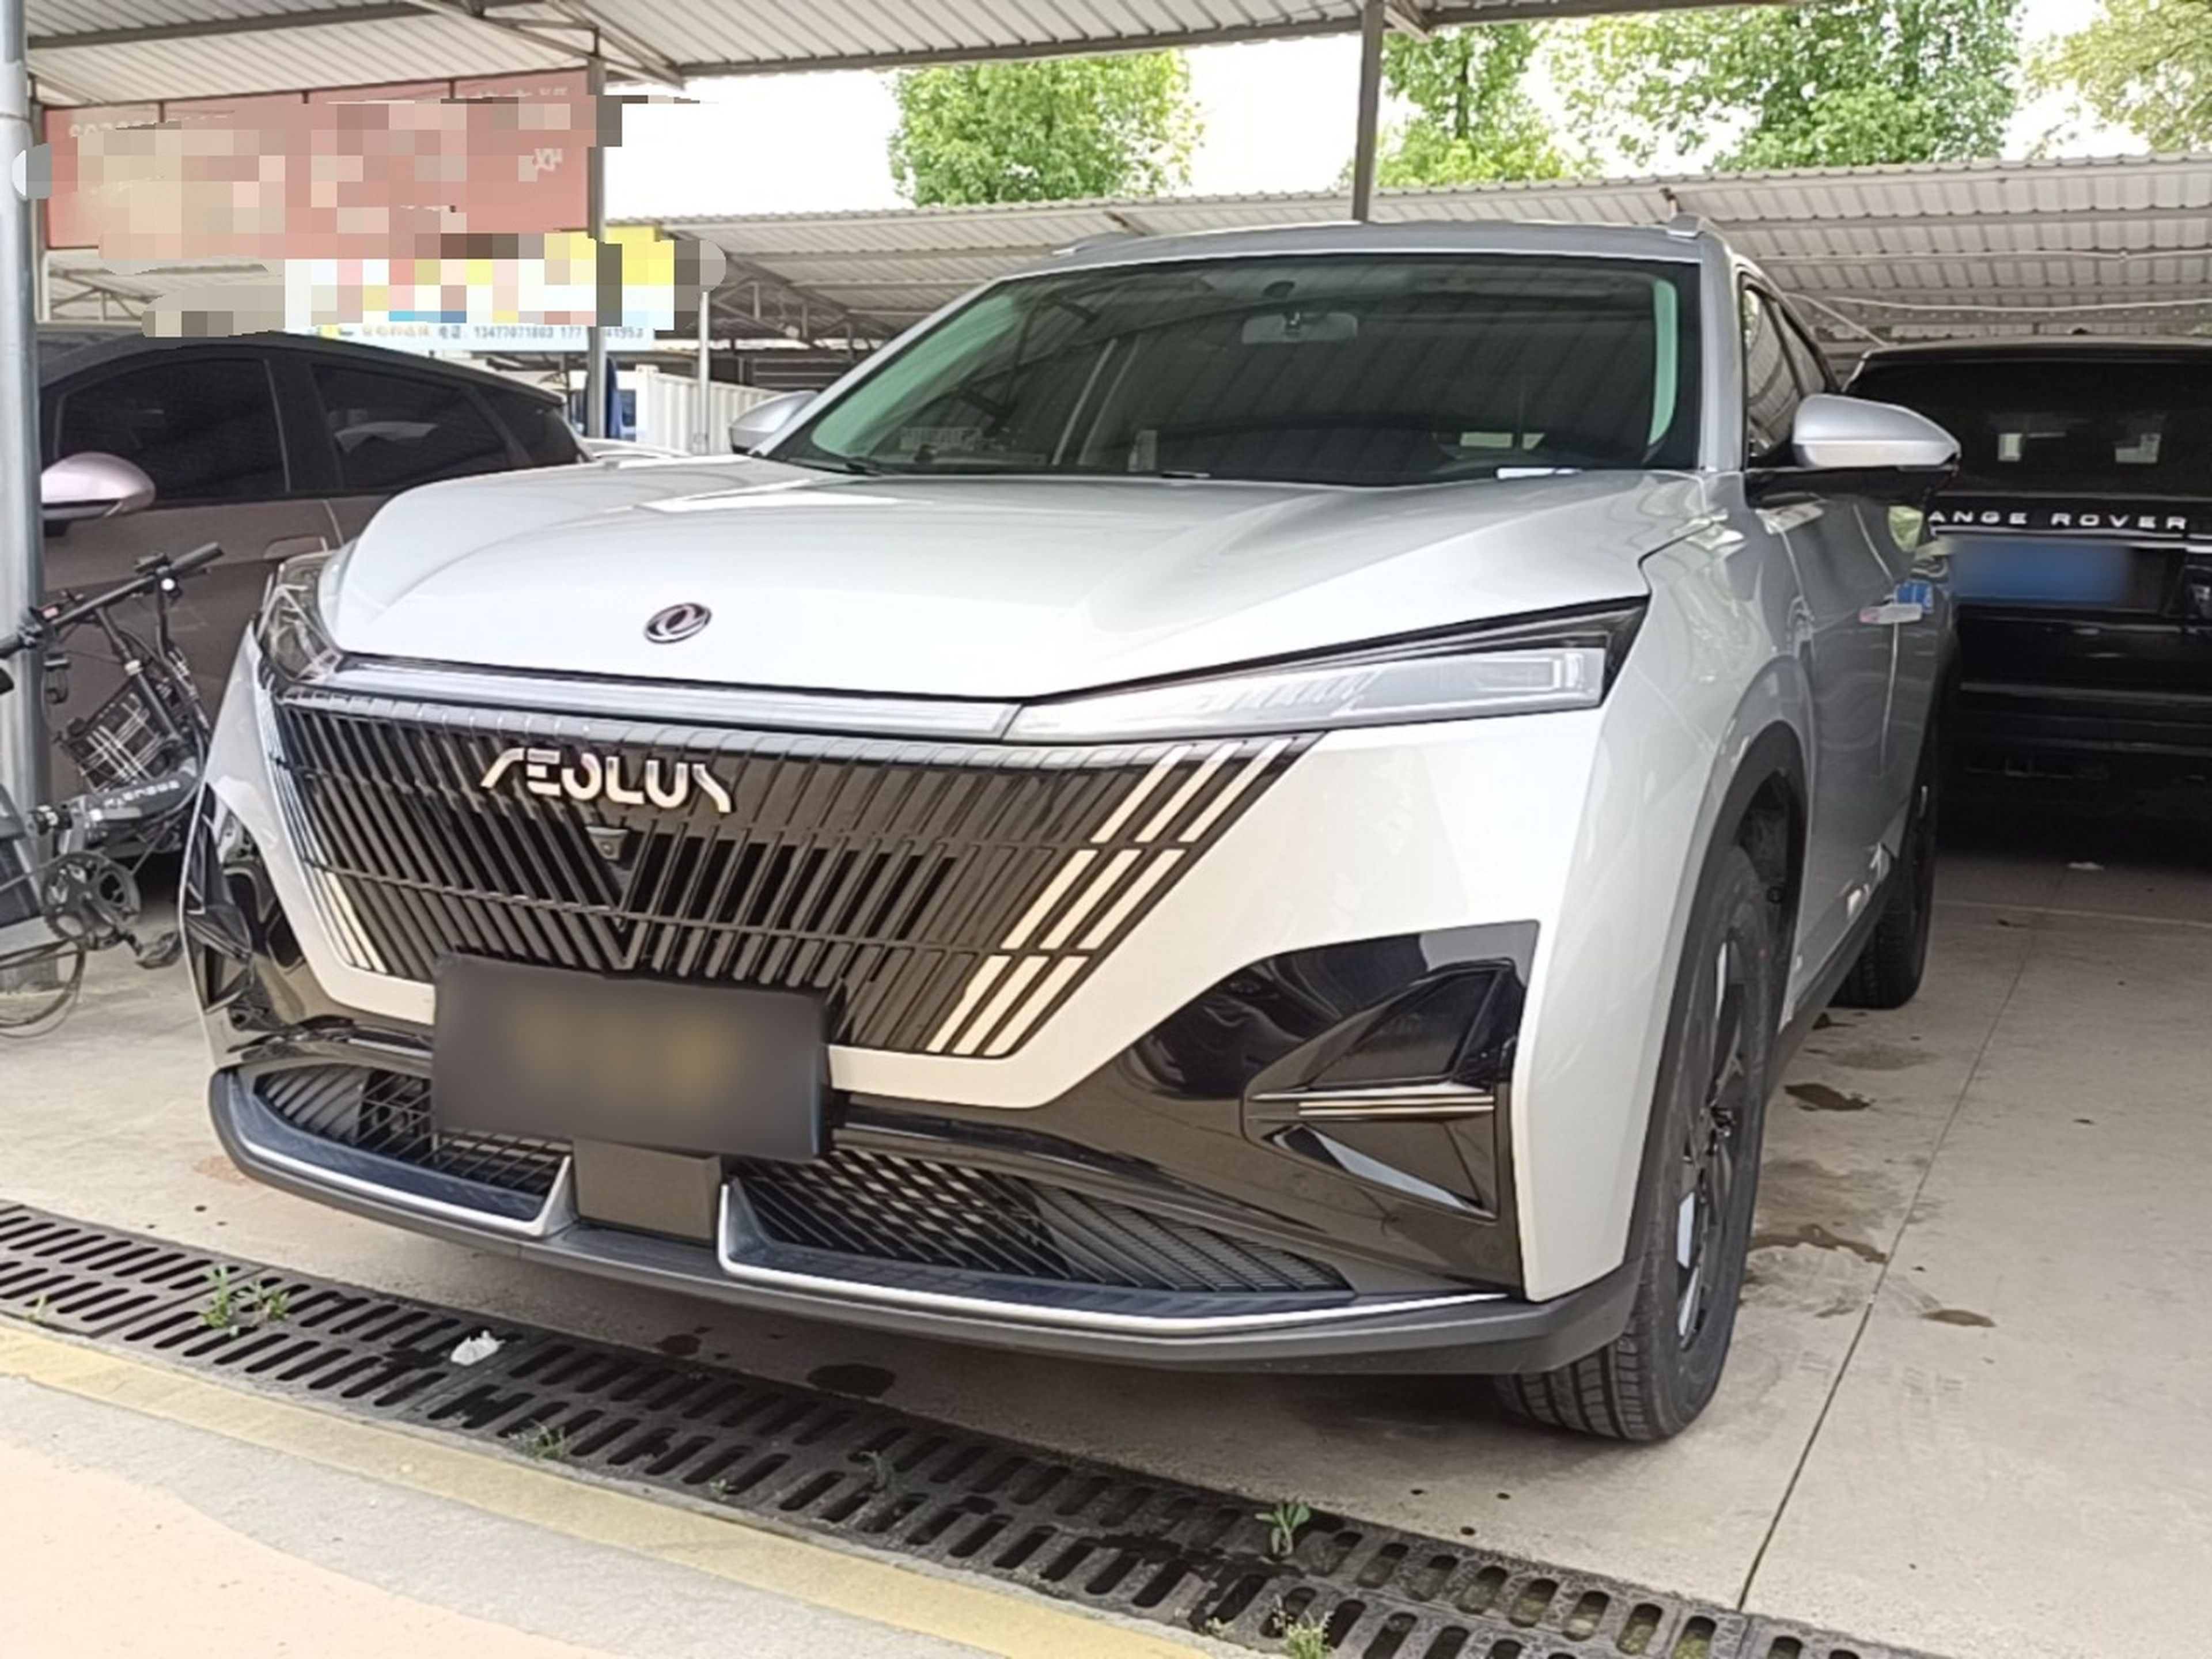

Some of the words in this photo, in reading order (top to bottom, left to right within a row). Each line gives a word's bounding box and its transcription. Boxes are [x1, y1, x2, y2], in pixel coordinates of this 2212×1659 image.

[1927, 510, 2028, 525] ANGE
[2051, 512, 2187, 529] ROVER
[480, 747, 732, 813] AEOLUS
